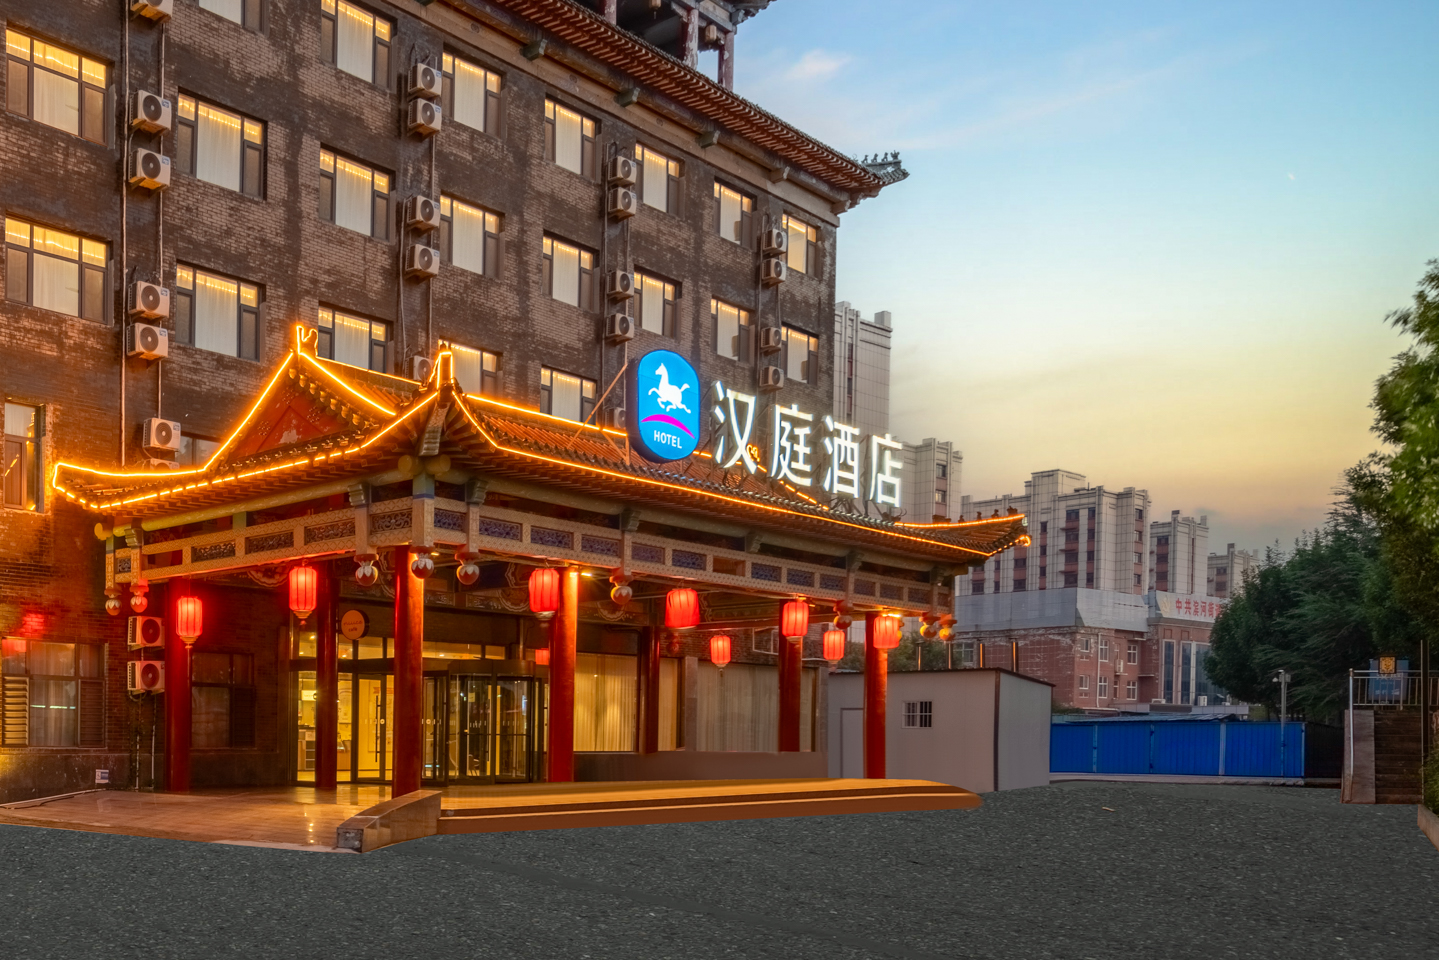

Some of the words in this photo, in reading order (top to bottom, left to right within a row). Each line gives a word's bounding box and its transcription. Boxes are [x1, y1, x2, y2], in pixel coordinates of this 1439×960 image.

[653, 430, 682, 449] HOTEL
[712, 380, 903, 508] 汉庭酒店
